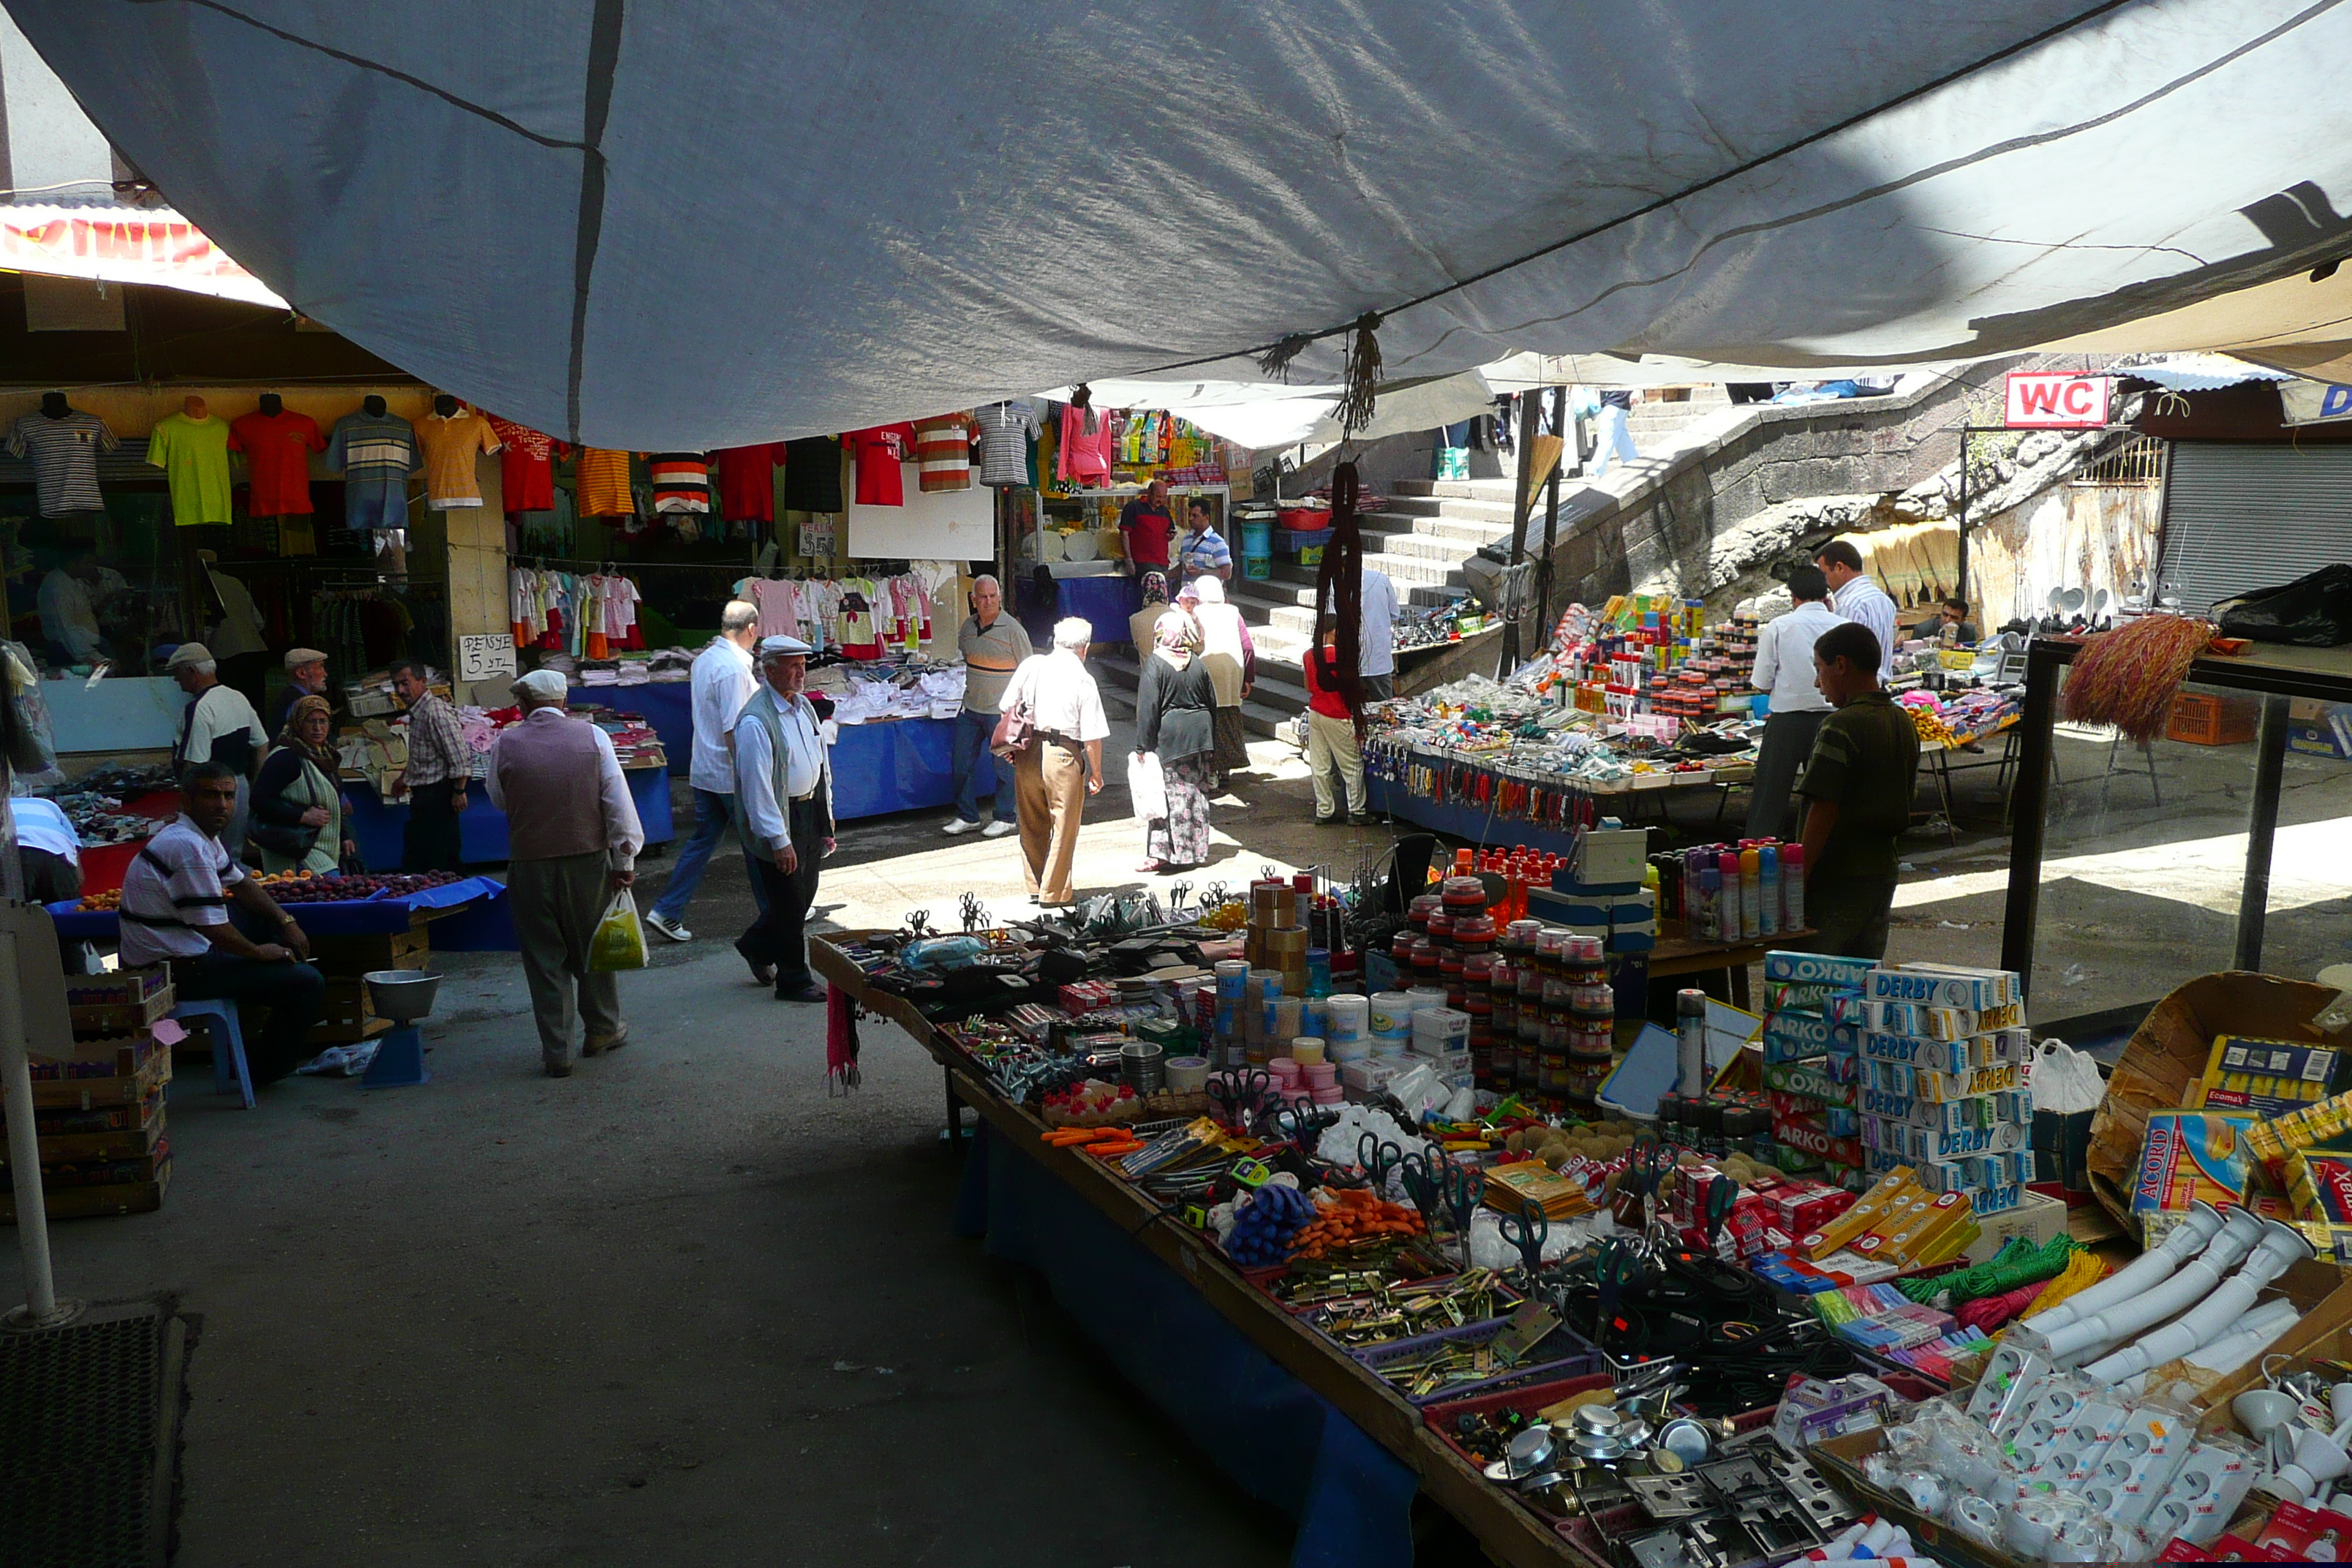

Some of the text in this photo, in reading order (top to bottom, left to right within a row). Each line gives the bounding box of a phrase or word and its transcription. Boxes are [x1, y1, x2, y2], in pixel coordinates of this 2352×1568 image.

[2019, 381, 2094, 415] WC
[464, 635, 511, 652] PENYE
[467, 654, 514, 674] 5 YTL
[1798, 960, 1867, 984] ARKO
[1876, 975, 1940, 1000] DERBY
[1770, 1017, 1828, 1042] ARKO
[1976, 1003, 2019, 1032] DERBY
[1866, 1033, 1920, 1062] DERBY
[1790, 1073, 1848, 1099] ARKO
[1967, 1065, 2015, 1094] DERBY
[1864, 1090, 1915, 1120] DERBY
[1779, 1124, 1828, 1153] ARKO
[1939, 1128, 1995, 1156] DERBY
[2139, 1129, 2168, 1199] ACORD
[1972, 1184, 2019, 1215] DERBY
